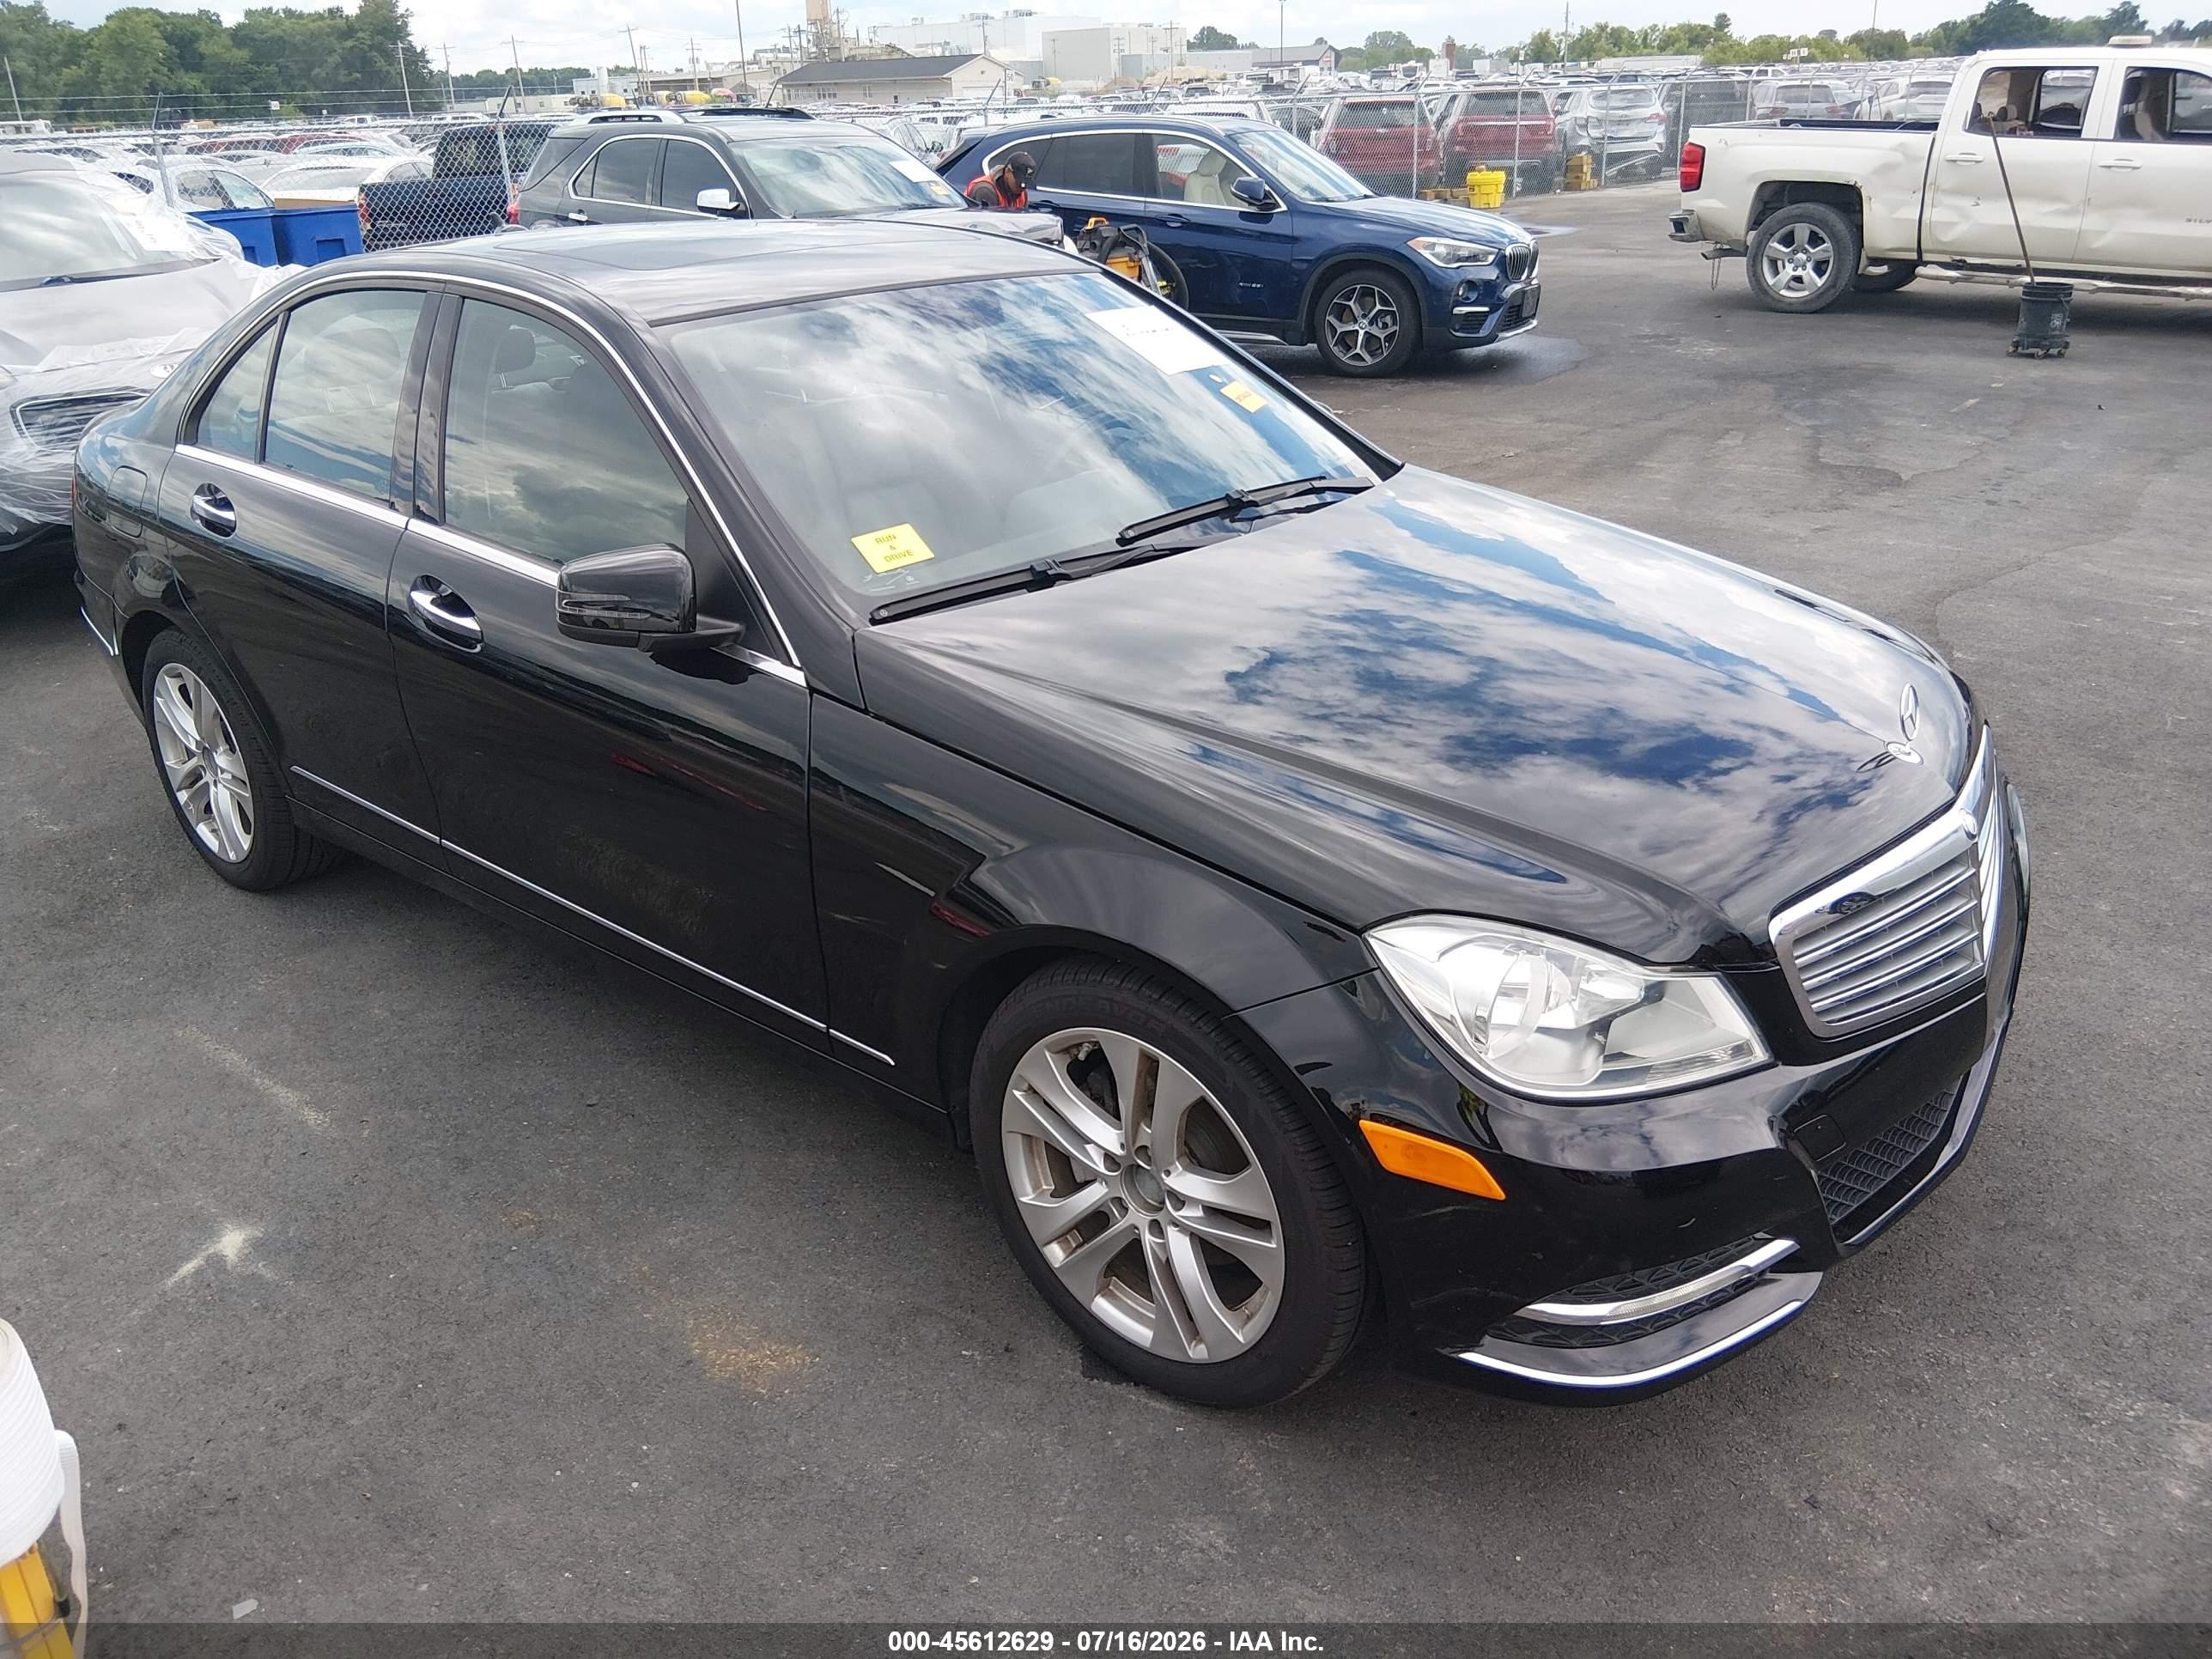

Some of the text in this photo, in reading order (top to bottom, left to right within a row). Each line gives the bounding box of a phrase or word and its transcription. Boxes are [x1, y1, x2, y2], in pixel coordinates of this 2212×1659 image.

[1006, 73, 1014, 82] 50
[874, 533, 896, 544] RUN
[884, 549, 914, 562] DRIVE
